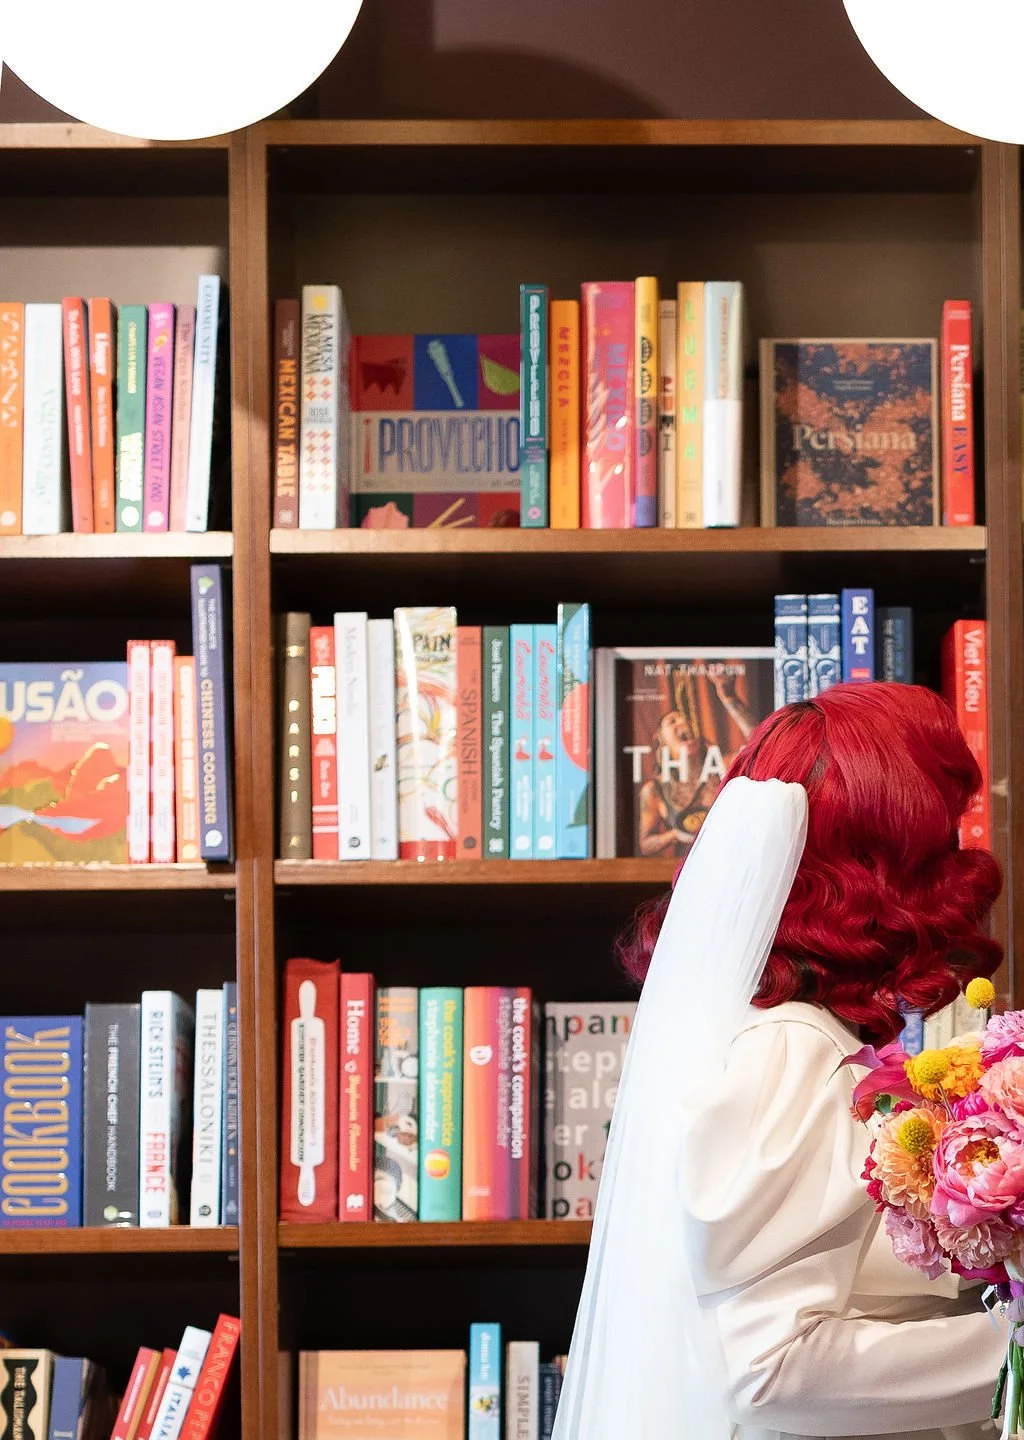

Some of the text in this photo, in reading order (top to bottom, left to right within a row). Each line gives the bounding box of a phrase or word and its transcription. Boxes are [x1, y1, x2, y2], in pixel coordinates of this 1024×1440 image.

[181, 322, 191, 342] The
[200, 284, 213, 366] COMMUNITY
[322, 313, 333, 330] LA
[278, 359, 296, 439] MEXICAN
[557, 327, 570, 408] MEZCLA
[606, 344, 625, 452] MEXICO
[151, 357, 166, 503] VEGAN ASIAN STREET FOOD
[792, 423, 917, 450] Persiana
[950, 344, 970, 474] Persiana EASY
[278, 443, 295, 497] TABLE
[491, 639, 503, 662] José
[850, 596, 869, 655] EAT
[965, 629, 983, 665] Viet
[644, 663, 674, 677] NAT
[201, 679, 217, 824] CHINESE COOKING
[461, 689, 477, 775] SPANISH
[491, 711, 503, 735] The
[489, 737, 503, 786] Spanish
[488, 788, 503, 830] Pantry
[148, 1010, 164, 1098] RICK STEIN'S
[346, 1000, 365, 1055] Home
[199, 1012, 217, 1164] THESSALONIKI
[346, 1075, 362, 1121] Stephanie
[425, 999, 438, 1142] stephanie alexander
[441, 1000, 455, 1146] the cook's apprentice
[497, 996, 510, 1148] stephanie alexander
[510, 997, 527, 1159] the cook's companion
[2, 1025, 71, 1216] COOKBOOK
[106, 1024, 118, 1192] THE FRENCH CHEF HANDBOOK
[145, 1132, 166, 1194] FRANCE
[14, 1366, 27, 1388] THE
[198, 1321, 238, 1406] FRANCO
[321, 1386, 448, 1411] Abundance
[516, 1375, 530, 1439] SIMPLE
